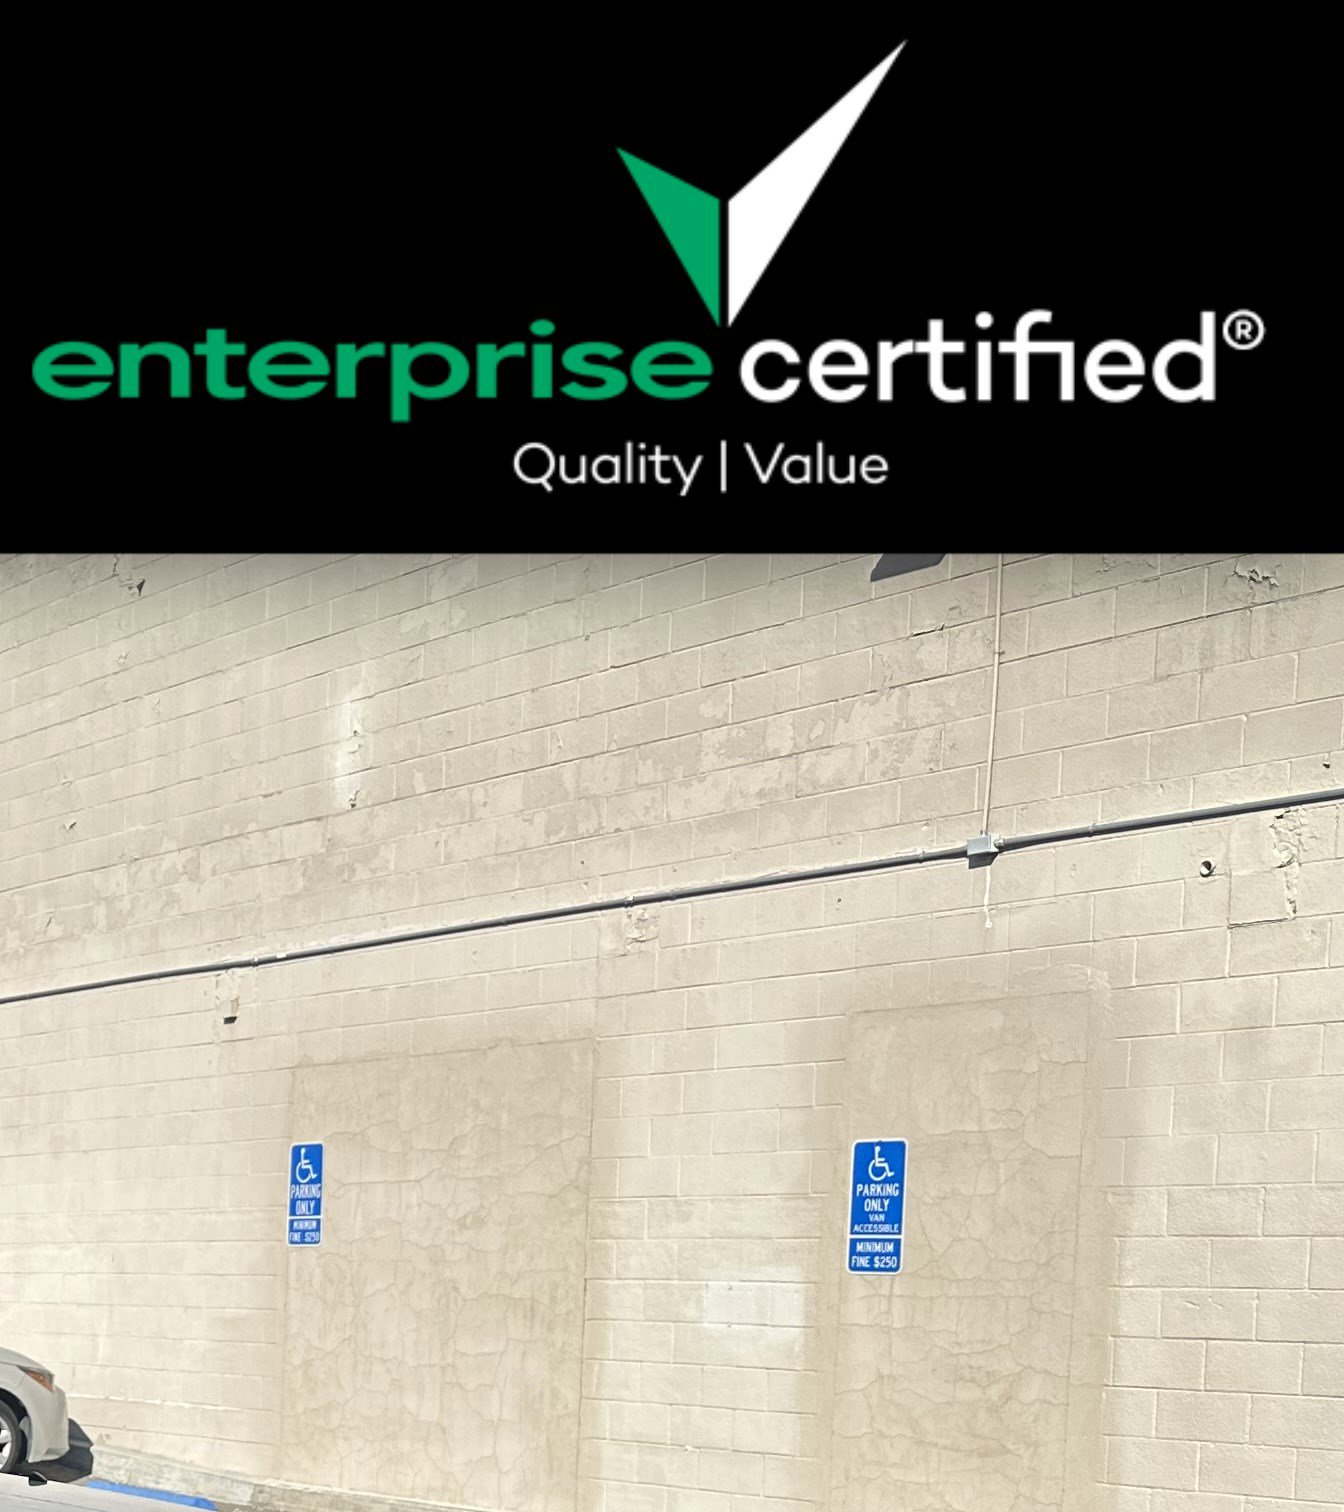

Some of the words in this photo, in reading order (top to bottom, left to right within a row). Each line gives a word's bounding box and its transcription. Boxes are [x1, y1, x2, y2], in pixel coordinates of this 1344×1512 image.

[291, 1184, 321, 1199] PARKING
[856, 1183, 899, 1197] PARKING
[295, 1200, 315, 1215] ONLY
[864, 1198, 890, 1212] ONLY
[869, 1214, 885, 1222] VAN
[852, 1223, 899, 1233] ACCESSIBLE
[856, 1242, 894, 1253] MINIMUM
[851, 1255, 870, 1268] FINE
[874, 1256, 897, 1268] $250
